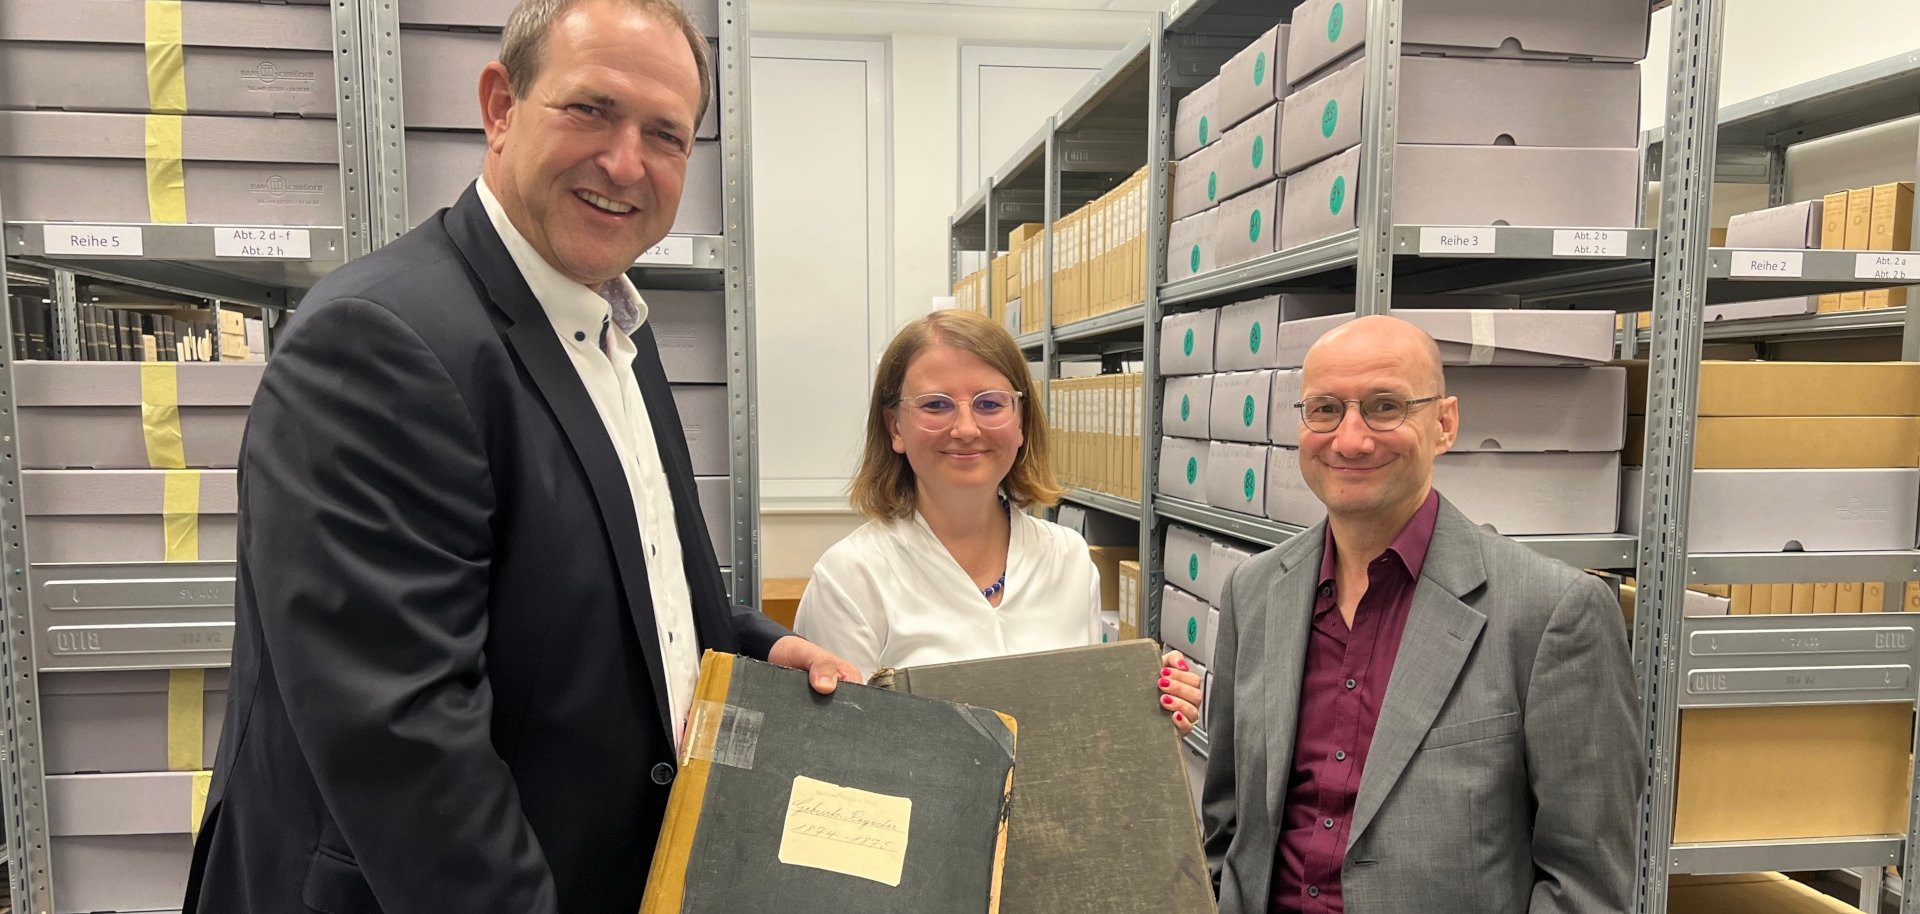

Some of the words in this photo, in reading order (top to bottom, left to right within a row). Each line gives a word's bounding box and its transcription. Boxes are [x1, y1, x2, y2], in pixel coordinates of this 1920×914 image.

[233, 230, 256, 240] Abt.
[259, 230, 266, 240] 2
[269, 230, 276, 240] d
[285, 230, 291, 240] f
[1574, 231, 1591, 240] Abt.
[1594, 232, 1600, 240] 2
[1602, 231, 1608, 240] b
[70, 235, 108, 247] Reihe
[112, 236, 120, 247] 5
[1440, 235, 1470, 246] Reihe
[1472, 236, 1479, 246] 3
[241, 246, 264, 256] Abt.
[267, 247, 274, 256] 2
[277, 247, 284, 256] h
[655, 246, 661, 255] 2
[1574, 245, 1591, 254] Abt.
[1594, 246, 1600, 254] 2
[1751, 260, 1778, 271] Reihe
[1781, 261, 1787, 271] 2
[1876, 257, 1892, 265] Abt.
[1895, 257, 1900, 265] 2
[1874, 270, 1891, 278] Abt.
[1893, 270, 1899, 279] 2
[1900, 270, 1906, 279] b
[792, 824, 838, 841] 1874
[851, 835, 893, 850] 1875
